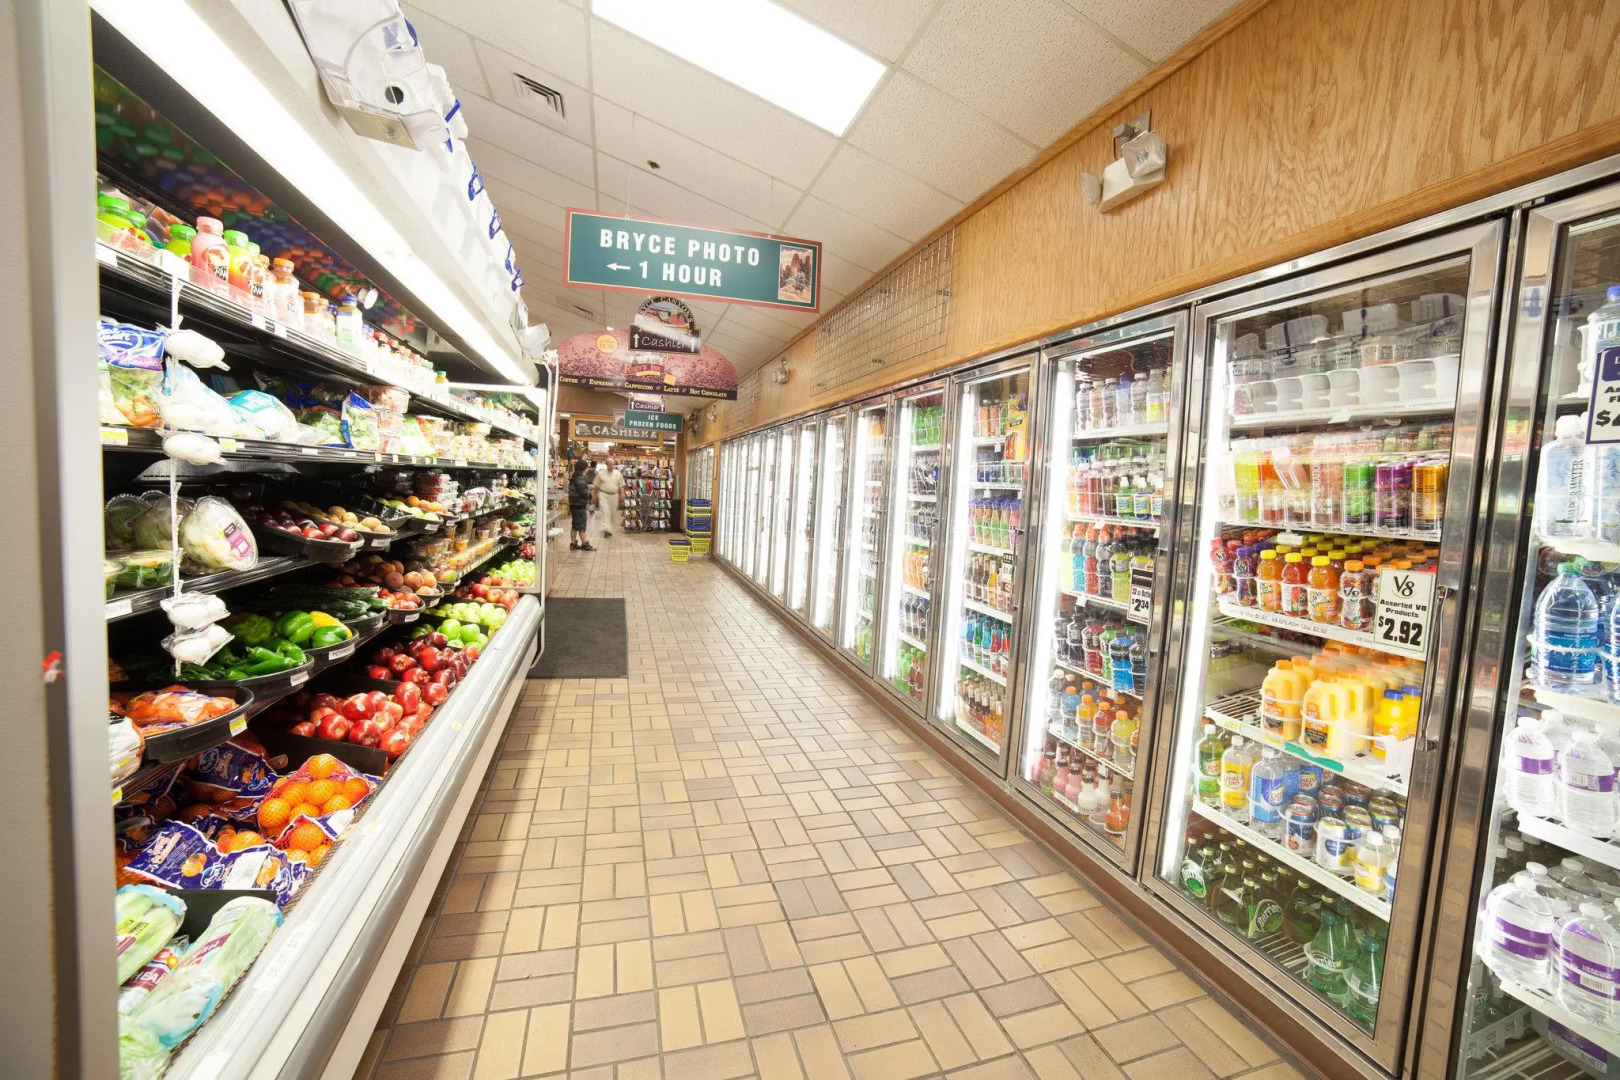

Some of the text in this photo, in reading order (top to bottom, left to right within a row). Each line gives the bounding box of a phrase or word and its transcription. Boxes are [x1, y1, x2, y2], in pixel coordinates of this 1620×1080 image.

[600, 228, 760, 267] BRYCE PHOTO
[639, 260, 723, 288] 1 HOUR
[641, 336, 686, 349] Cashier
[635, 402, 660, 411] Cashier
[629, 420, 677, 430] FROZEN FOODS
[1393, 574, 1415, 597] V8
[1380, 599, 1413, 610] Assorted
[1385, 607, 1419, 618] Products
[1378, 615, 1423, 647] $2.92
